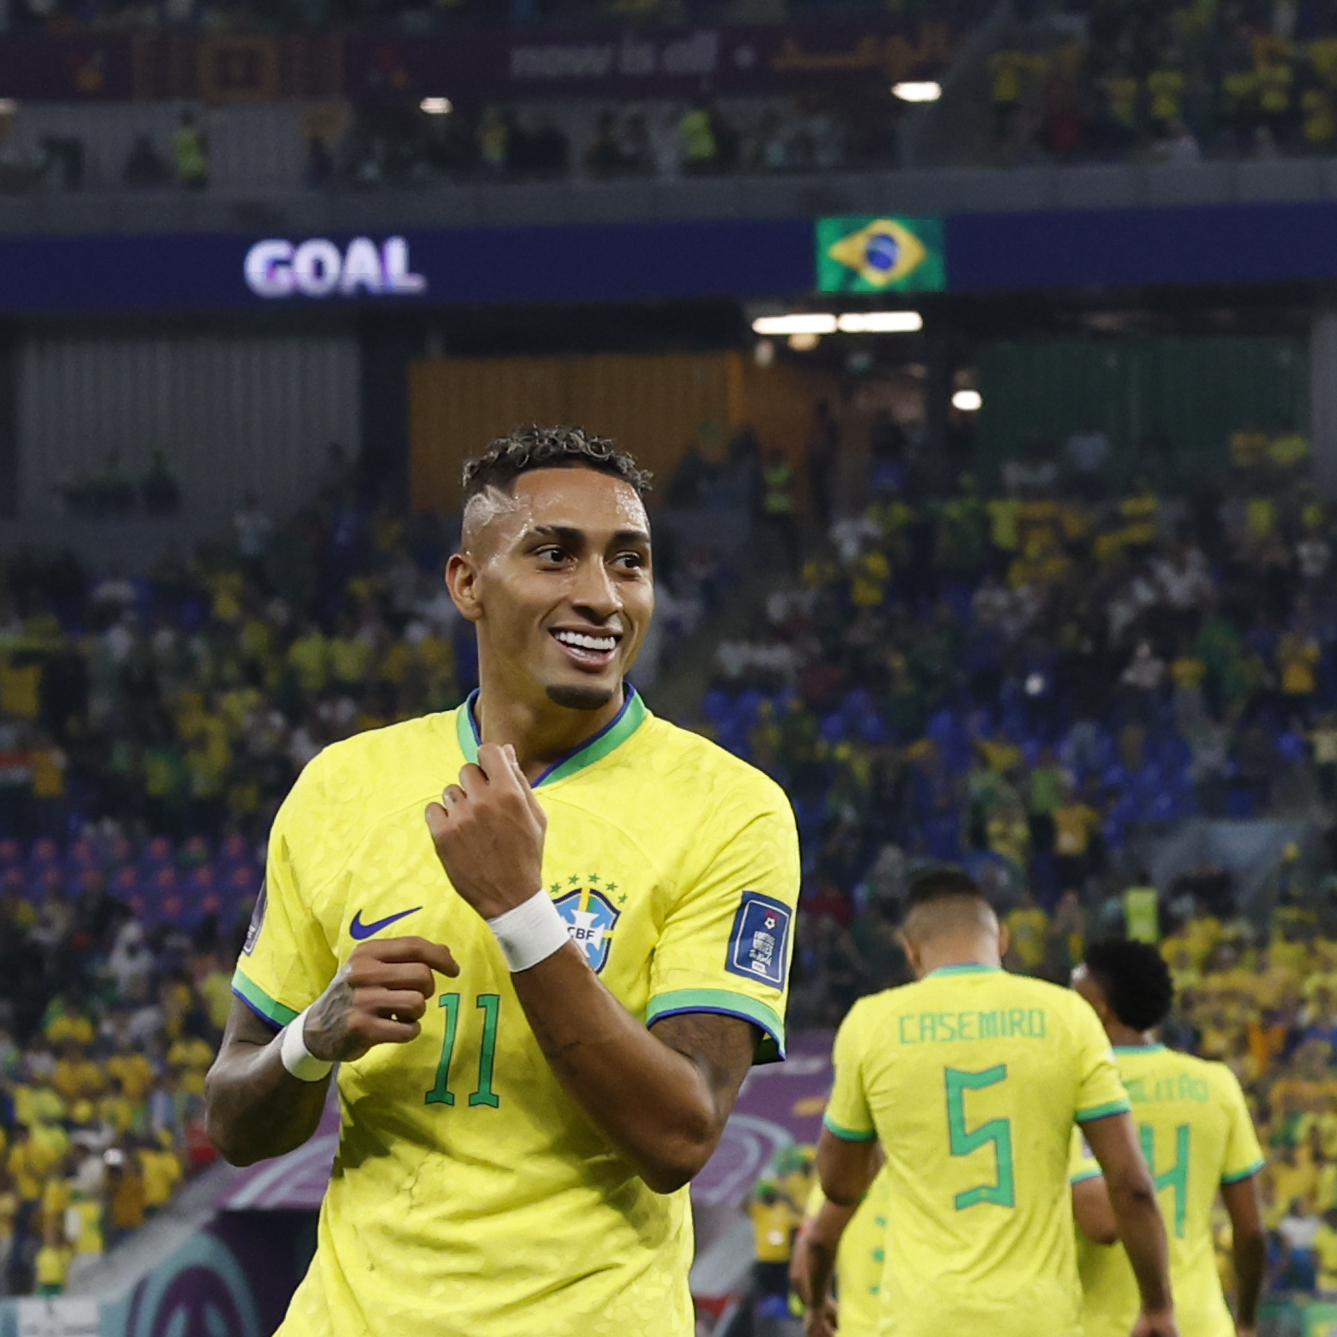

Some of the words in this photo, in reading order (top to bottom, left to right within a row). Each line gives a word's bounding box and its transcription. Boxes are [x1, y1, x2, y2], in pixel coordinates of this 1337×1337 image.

[244, 236, 427, 298] GOAL
[425, 992, 501, 1109] 11
[898, 1008, 1047, 1045] CASEMIRO
[944, 1063, 1015, 1211] 5
[1139, 1123, 1191, 1239] 4
